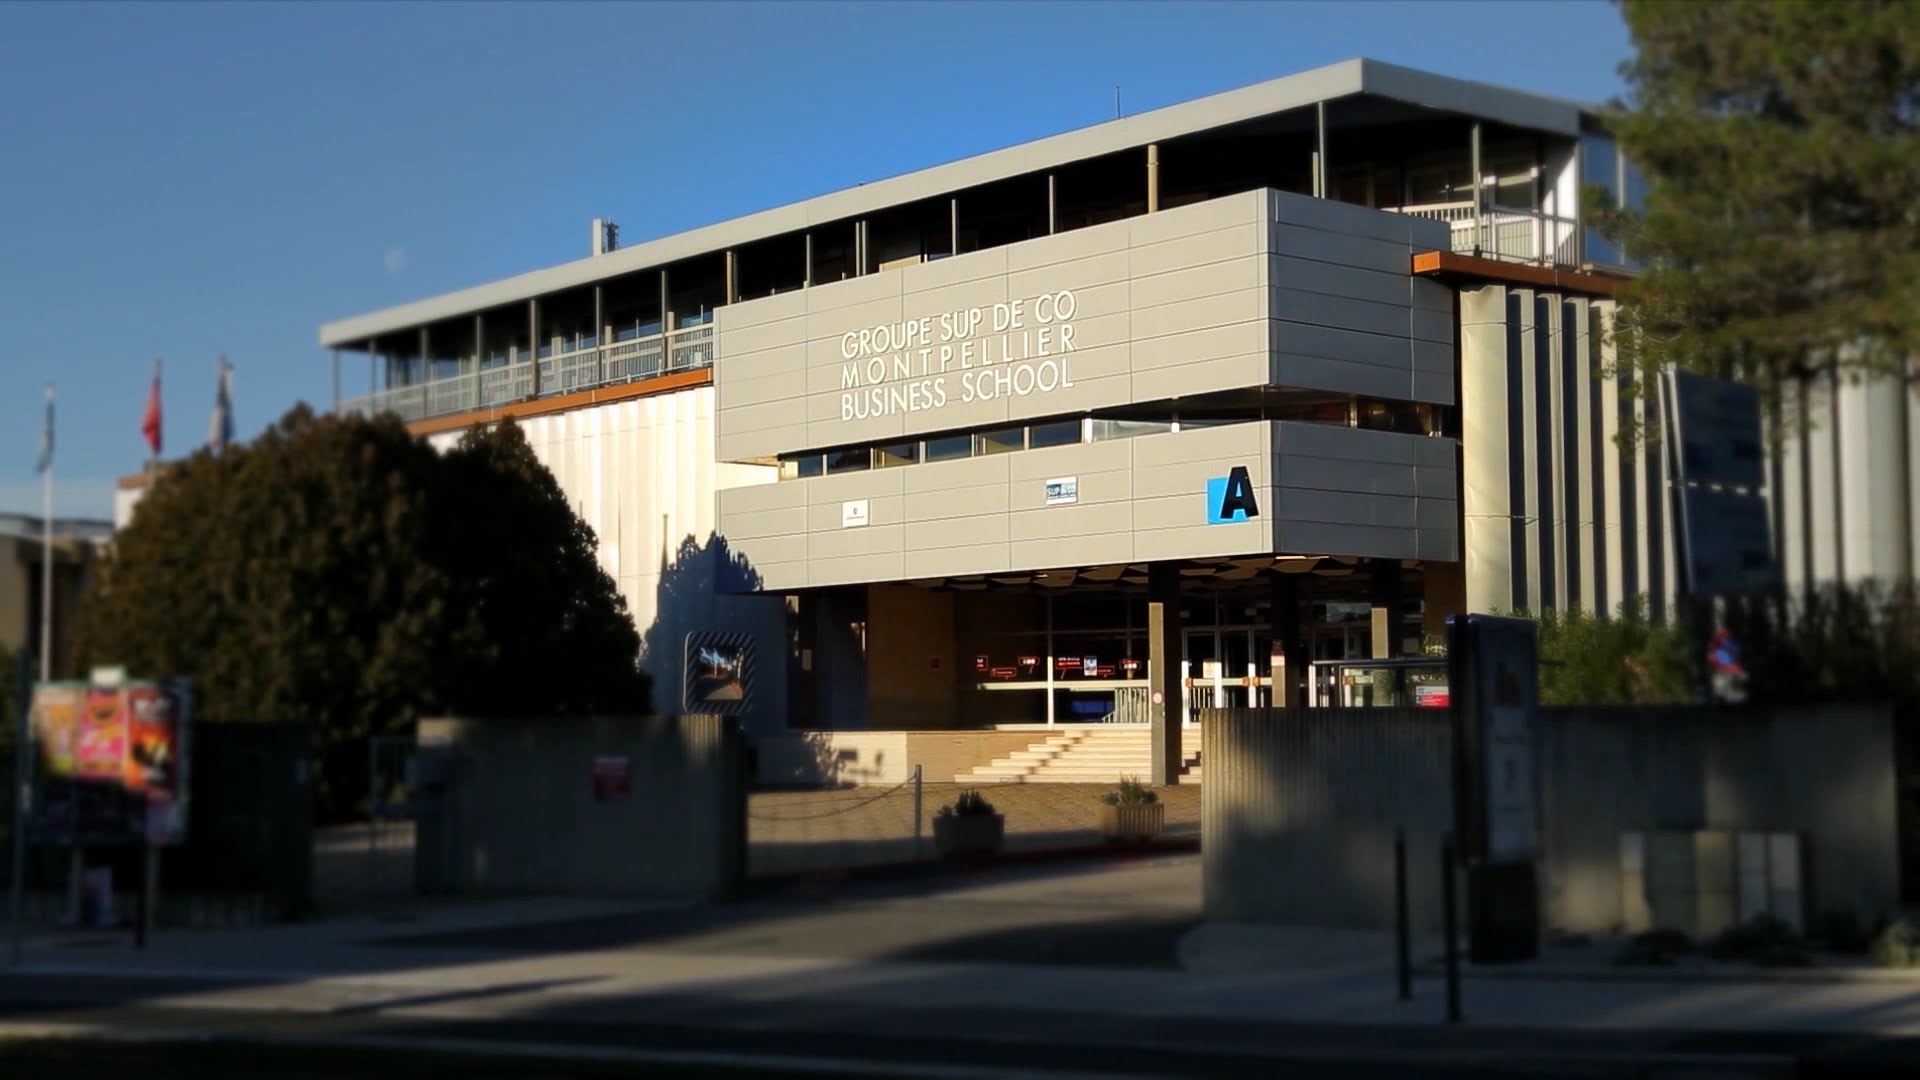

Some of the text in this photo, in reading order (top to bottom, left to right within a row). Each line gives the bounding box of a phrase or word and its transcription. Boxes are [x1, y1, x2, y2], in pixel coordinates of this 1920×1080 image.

[841, 290, 1077, 359] GROUPE SUP DE CO
[841, 324, 1076, 390] MONTPELLIER
[842, 358, 1074, 422] BUSINESS SCHOOL
[1220, 466, 1259, 519] A
